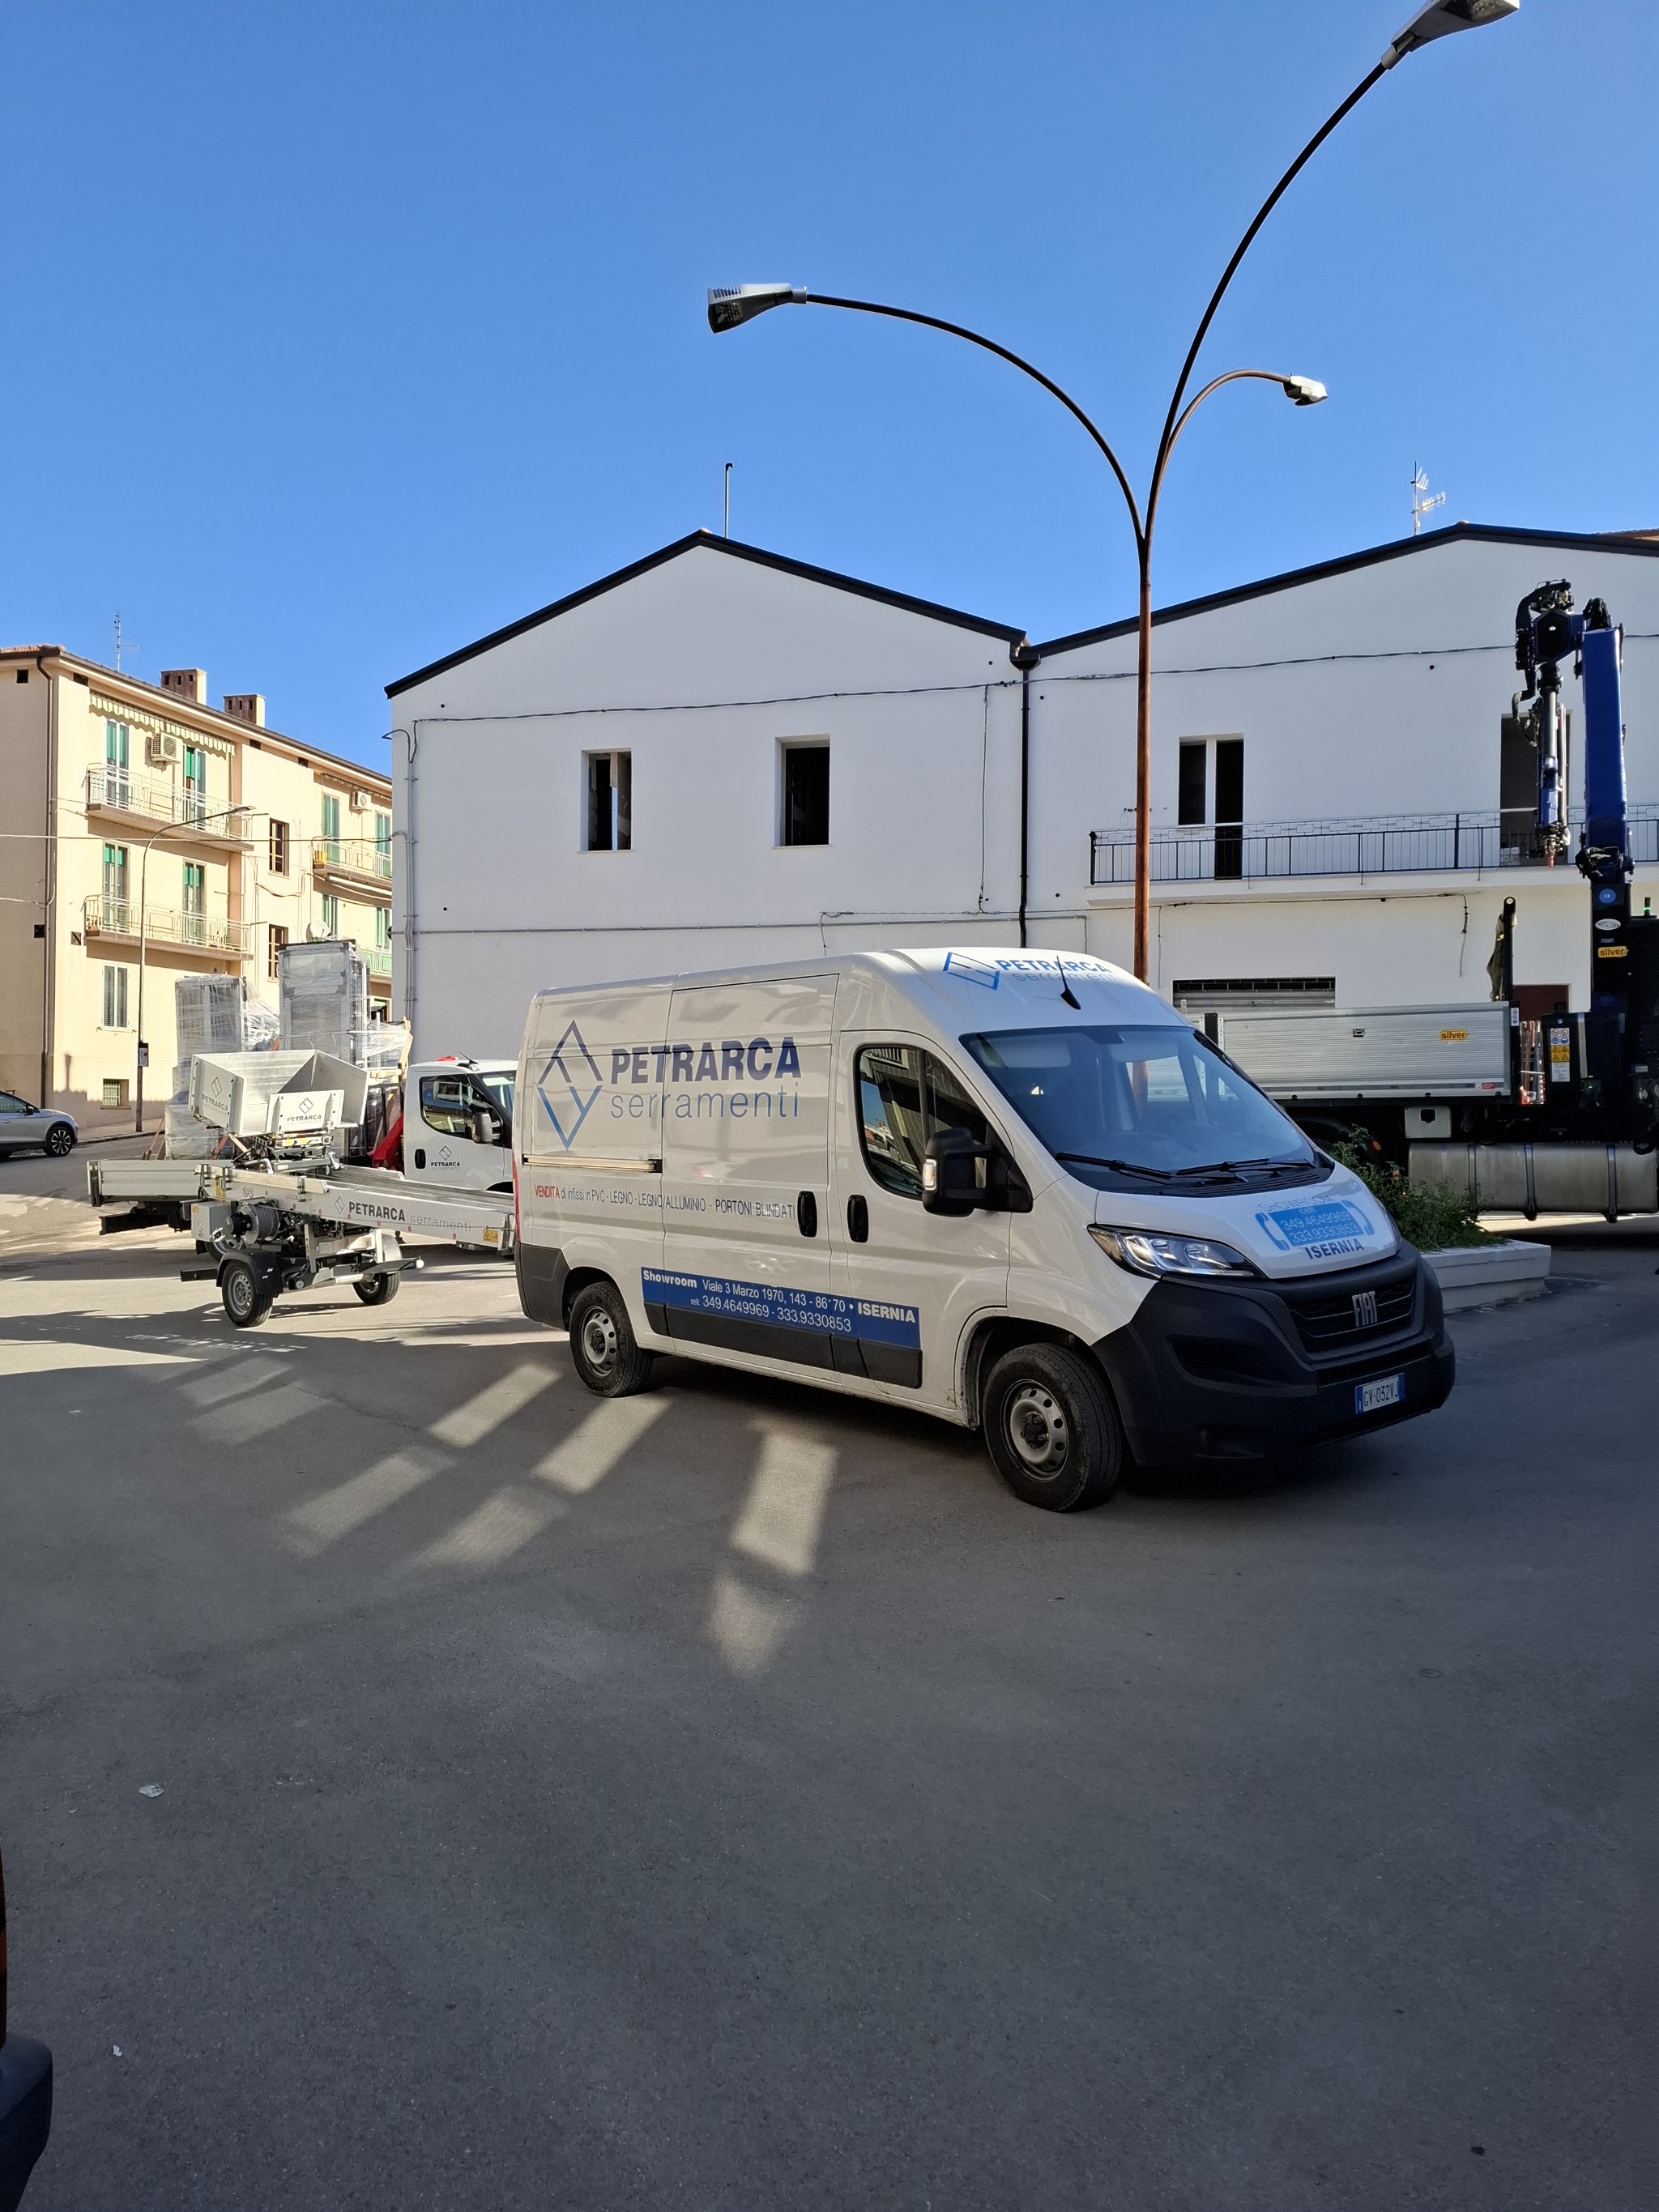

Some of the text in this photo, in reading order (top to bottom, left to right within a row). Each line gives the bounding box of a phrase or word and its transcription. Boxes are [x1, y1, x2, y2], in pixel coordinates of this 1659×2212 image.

[1600, 948, 1625, 957] silver
[995, 960, 1112, 974] PETRARCA
[1442, 1031, 1465, 1039] silver
[611, 1037, 802, 1085] PETRARCA
[203, 1094, 228, 1111] PETRARCA
[610, 1082, 800, 1119] serramenti
[348, 1201, 406, 1221] PETRARCA
[535, 1185, 561, 1200] VENDITA
[561, 1187, 566, 1200] di
[567, 1187, 584, 1201] infissi
[585, 1189, 591, 1202] in
[591, 1190, 605, 1203] PVC
[610, 1191, 633, 1205] LEGNO
[715, 1199, 752, 1216] PORTONI
[756, 1202, 795, 1219] BLINDATI
[1258, 1195, 1336, 1212] SHOWROOM
[410, 1214, 471, 1232] serramenti
[1281, 1211, 1351, 1230] 349.4649969
[1290, 1223, 1359, 1243] 333.9330853
[1304, 1238, 1365, 1259] ISERNIA
[643, 1269, 697, 1289] Showroom
[702, 1279, 723, 1293] Viale
[725, 1283, 731, 1294] 3
[732, 1284, 760, 1298] Marzo
[762, 1288, 787, 1305] 1970,
[790, 1292, 807, 1306] 143
[858, 1302, 916, 1323] ISERNIA
[702, 1295, 770, 1318] 349.4649969
[777, 1307, 851, 1332] 333.9330853
[1351, 1290, 1377, 1328] FIAT
